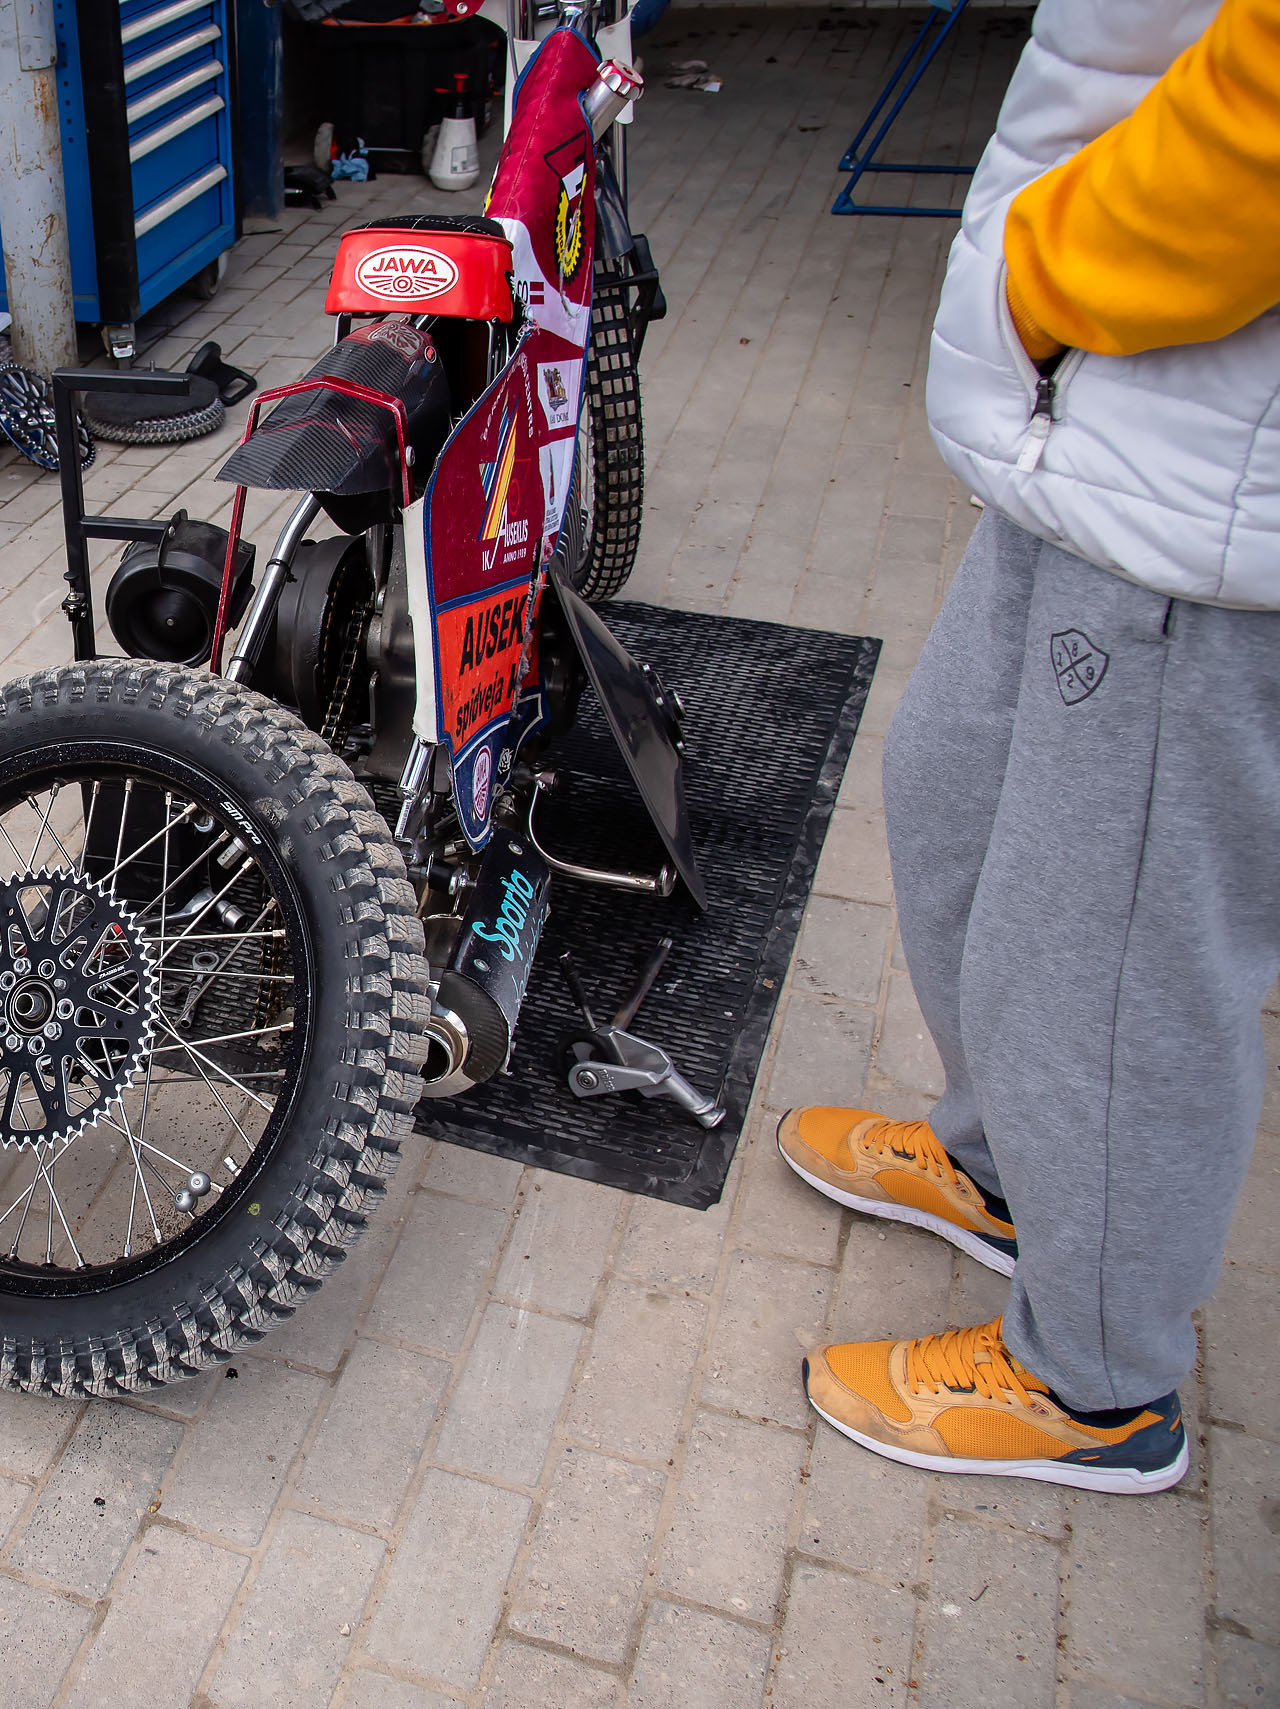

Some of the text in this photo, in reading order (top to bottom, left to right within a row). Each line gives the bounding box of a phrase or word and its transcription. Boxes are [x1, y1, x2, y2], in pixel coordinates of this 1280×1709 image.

[372, 257, 438, 275] JAWA
[459, 594, 526, 676] AUSEK
[238, 820, 262, 845] Pro
[472, 869, 534, 962] Sparta
